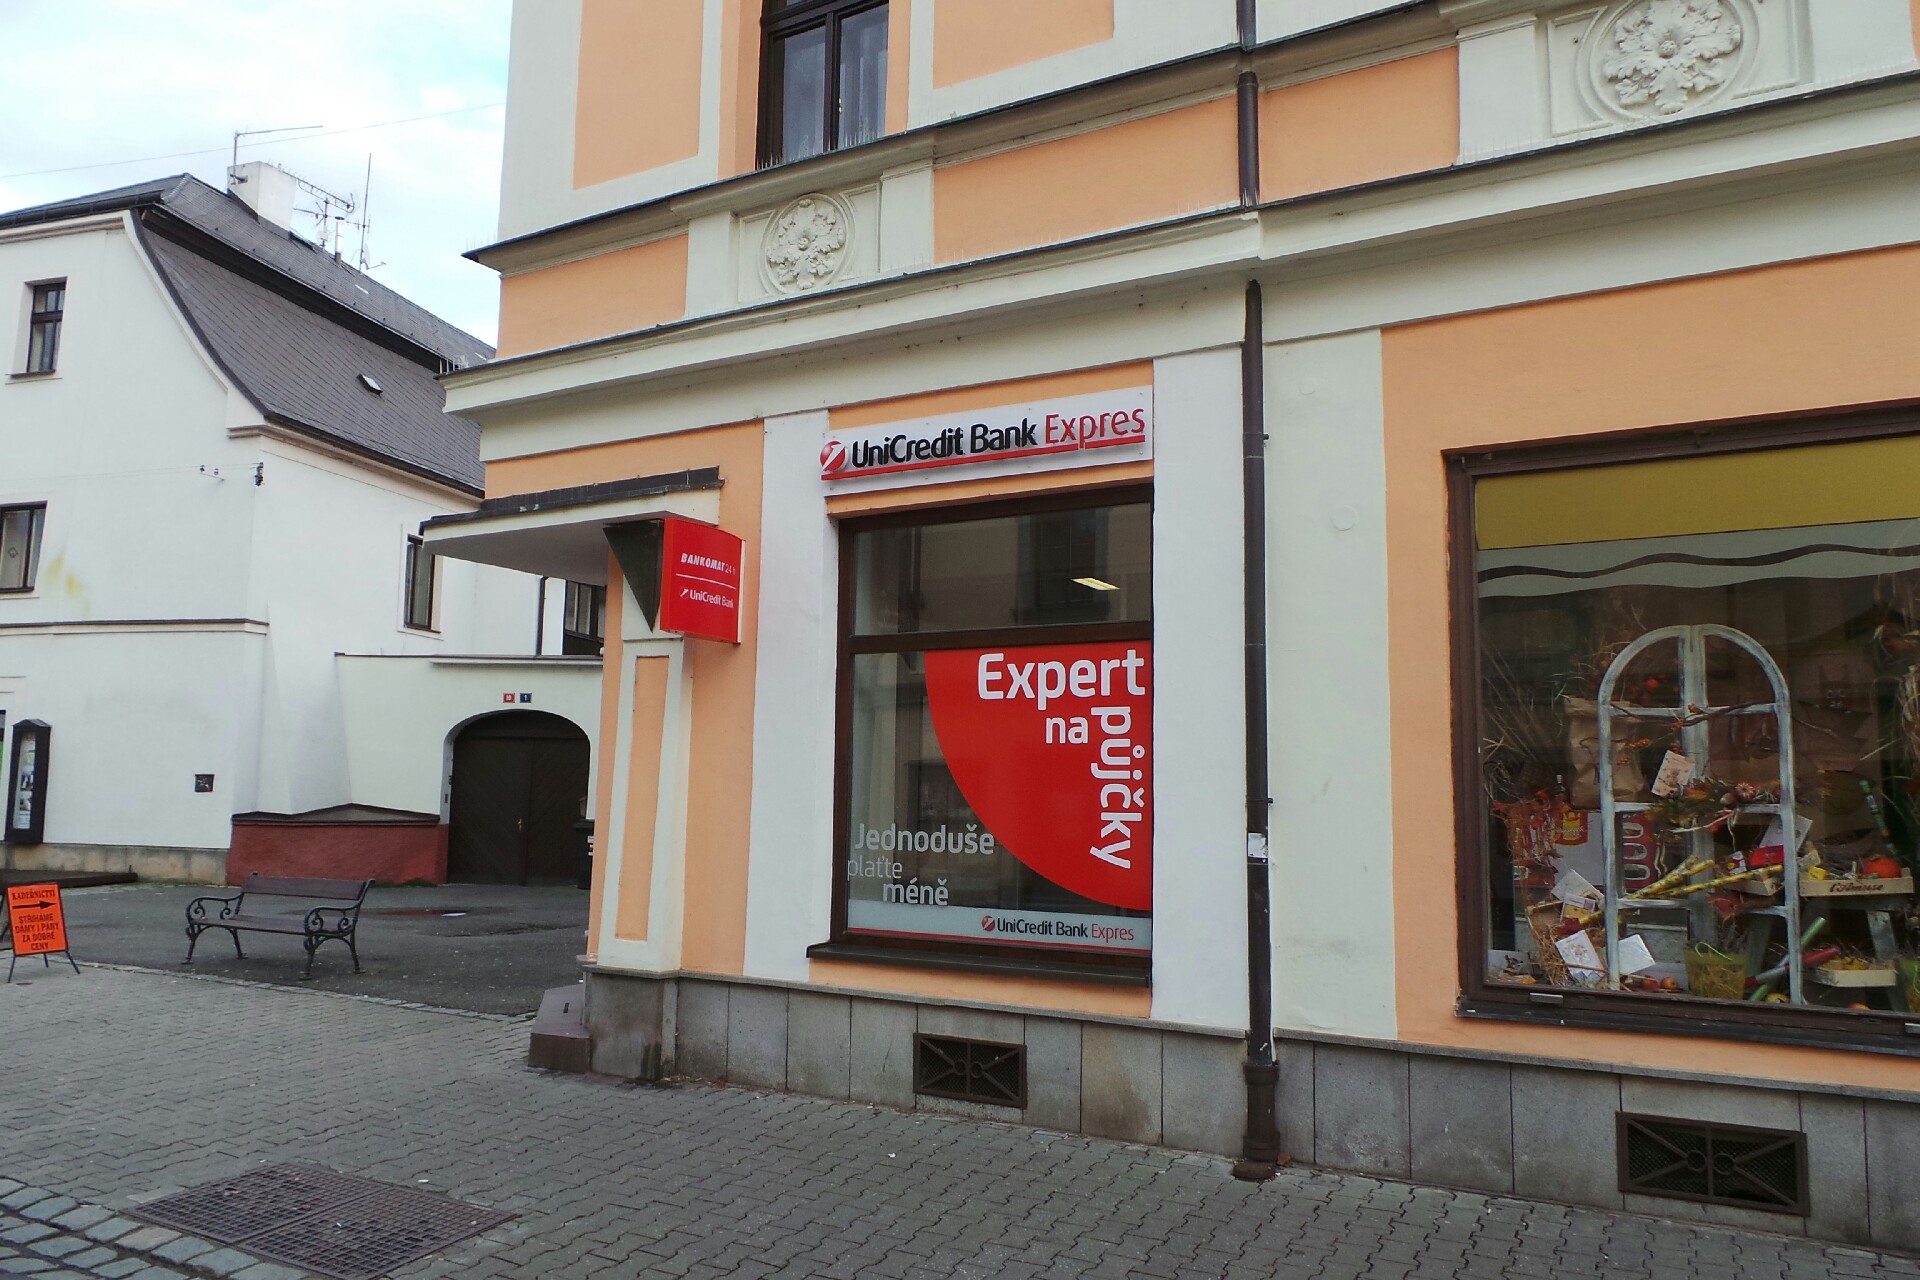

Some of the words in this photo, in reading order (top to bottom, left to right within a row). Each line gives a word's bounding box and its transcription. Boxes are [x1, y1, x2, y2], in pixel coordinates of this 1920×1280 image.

[851, 426, 964, 468] UniCredit
[970, 418, 1037, 453] Bank
[1045, 408, 1146, 449] Expres
[681, 553, 725, 572] BANKOMAT
[690, 590, 721, 606] UniCredit
[721, 596, 734, 608] Bank
[977, 649, 1146, 711] Expert
[1045, 716, 1089, 744] na
[1089, 706, 1145, 869] půjčky
[855, 823, 995, 855] Jednoduše
[847, 855, 903, 881] plaťte
[882, 876, 949, 906] méně
[22, 934, 31, 943] ZA
[997, 917, 1053, 935] UniCredit
[1056, 921, 1089, 938] Bank
[1091, 923, 1134, 943] Expres
[31, 942, 49, 951] CENY
